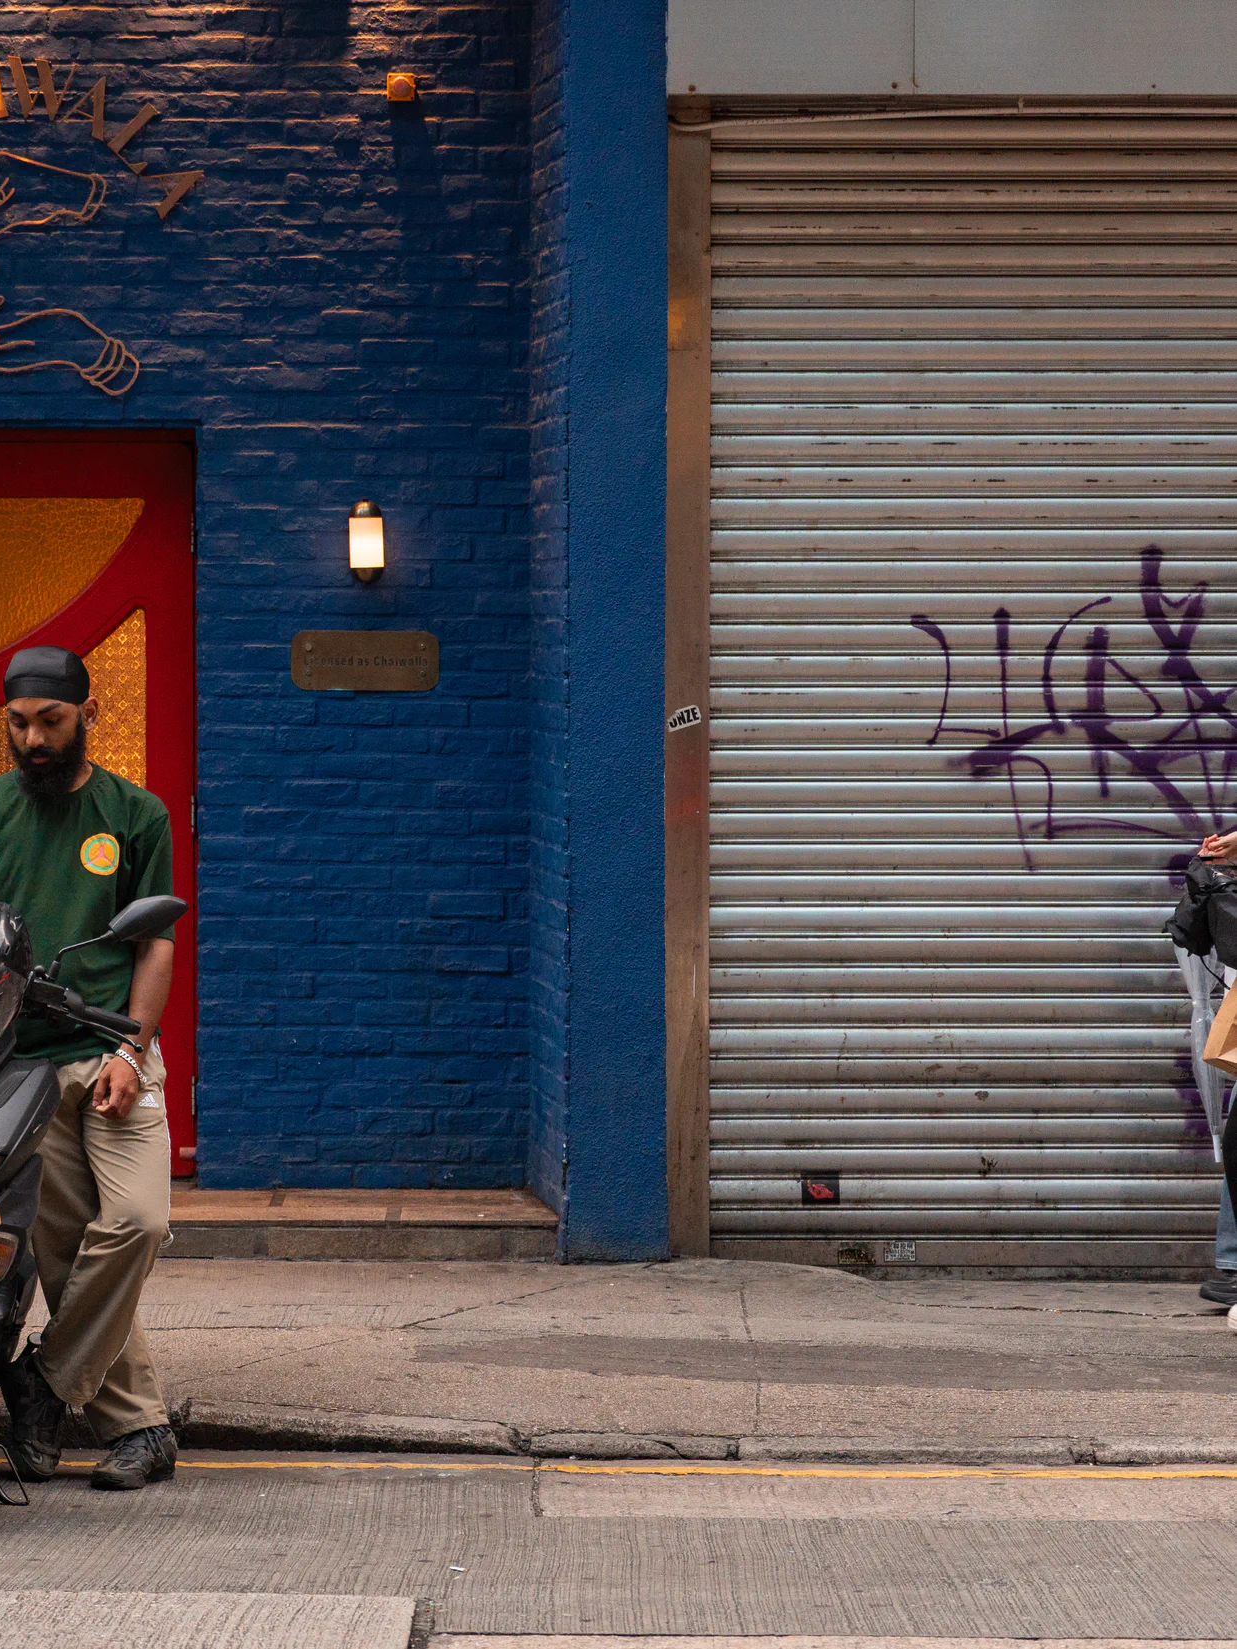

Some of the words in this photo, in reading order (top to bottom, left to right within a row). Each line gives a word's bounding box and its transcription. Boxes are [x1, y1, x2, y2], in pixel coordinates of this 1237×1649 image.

[303, 656, 354, 666] Licensed
[358, 658, 370, 666] as
[374, 656, 428, 667] Chaiwalla
